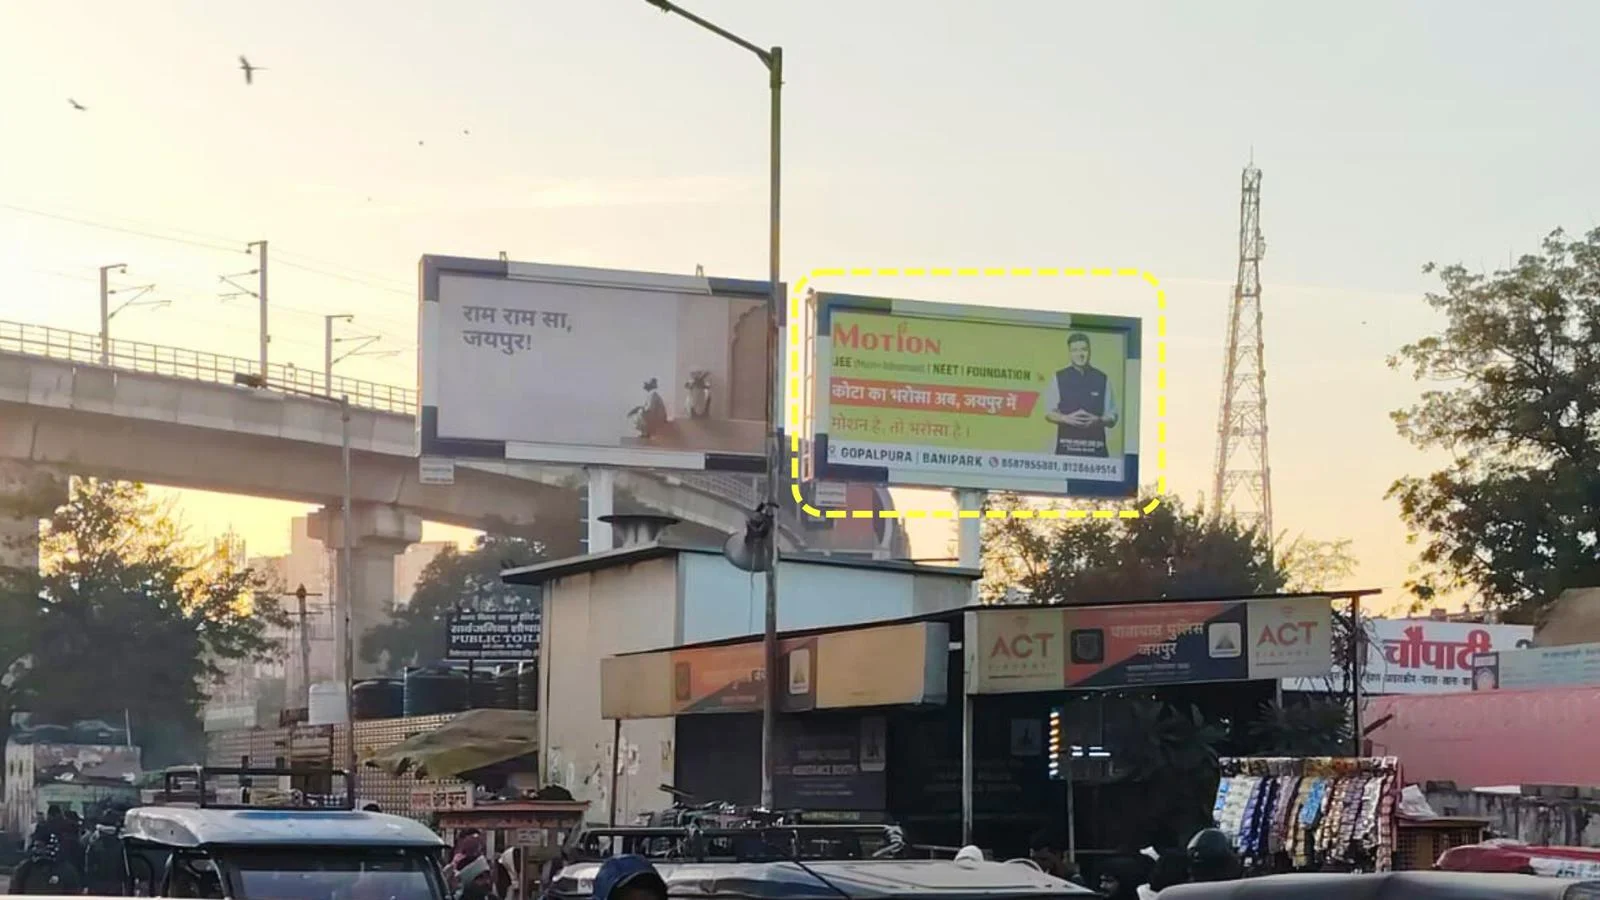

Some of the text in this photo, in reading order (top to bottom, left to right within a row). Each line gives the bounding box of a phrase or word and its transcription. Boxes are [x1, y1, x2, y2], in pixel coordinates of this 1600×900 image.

[462, 305, 572, 333] राम राम सा,
[462, 330, 532, 355] जयपुर!
[833, 356, 852, 368] JEE
[933, 363, 959, 376] NEET
[966, 365, 1031, 381] FOUNDATION
[832, 380, 1018, 414] कोटा का भरोसा अब, जयपुर में
[841, 447, 913, 462] GOPALPURA
[923, 452, 983, 467] BANIPARK
[451, 634, 500, 643] PUBLIC
[1167, 618, 1204, 641] पुलिस
[1257, 620, 1318, 647] ACT
[991, 632, 1056, 659] ACT
[1138, 642, 1178, 660] जयपुर
